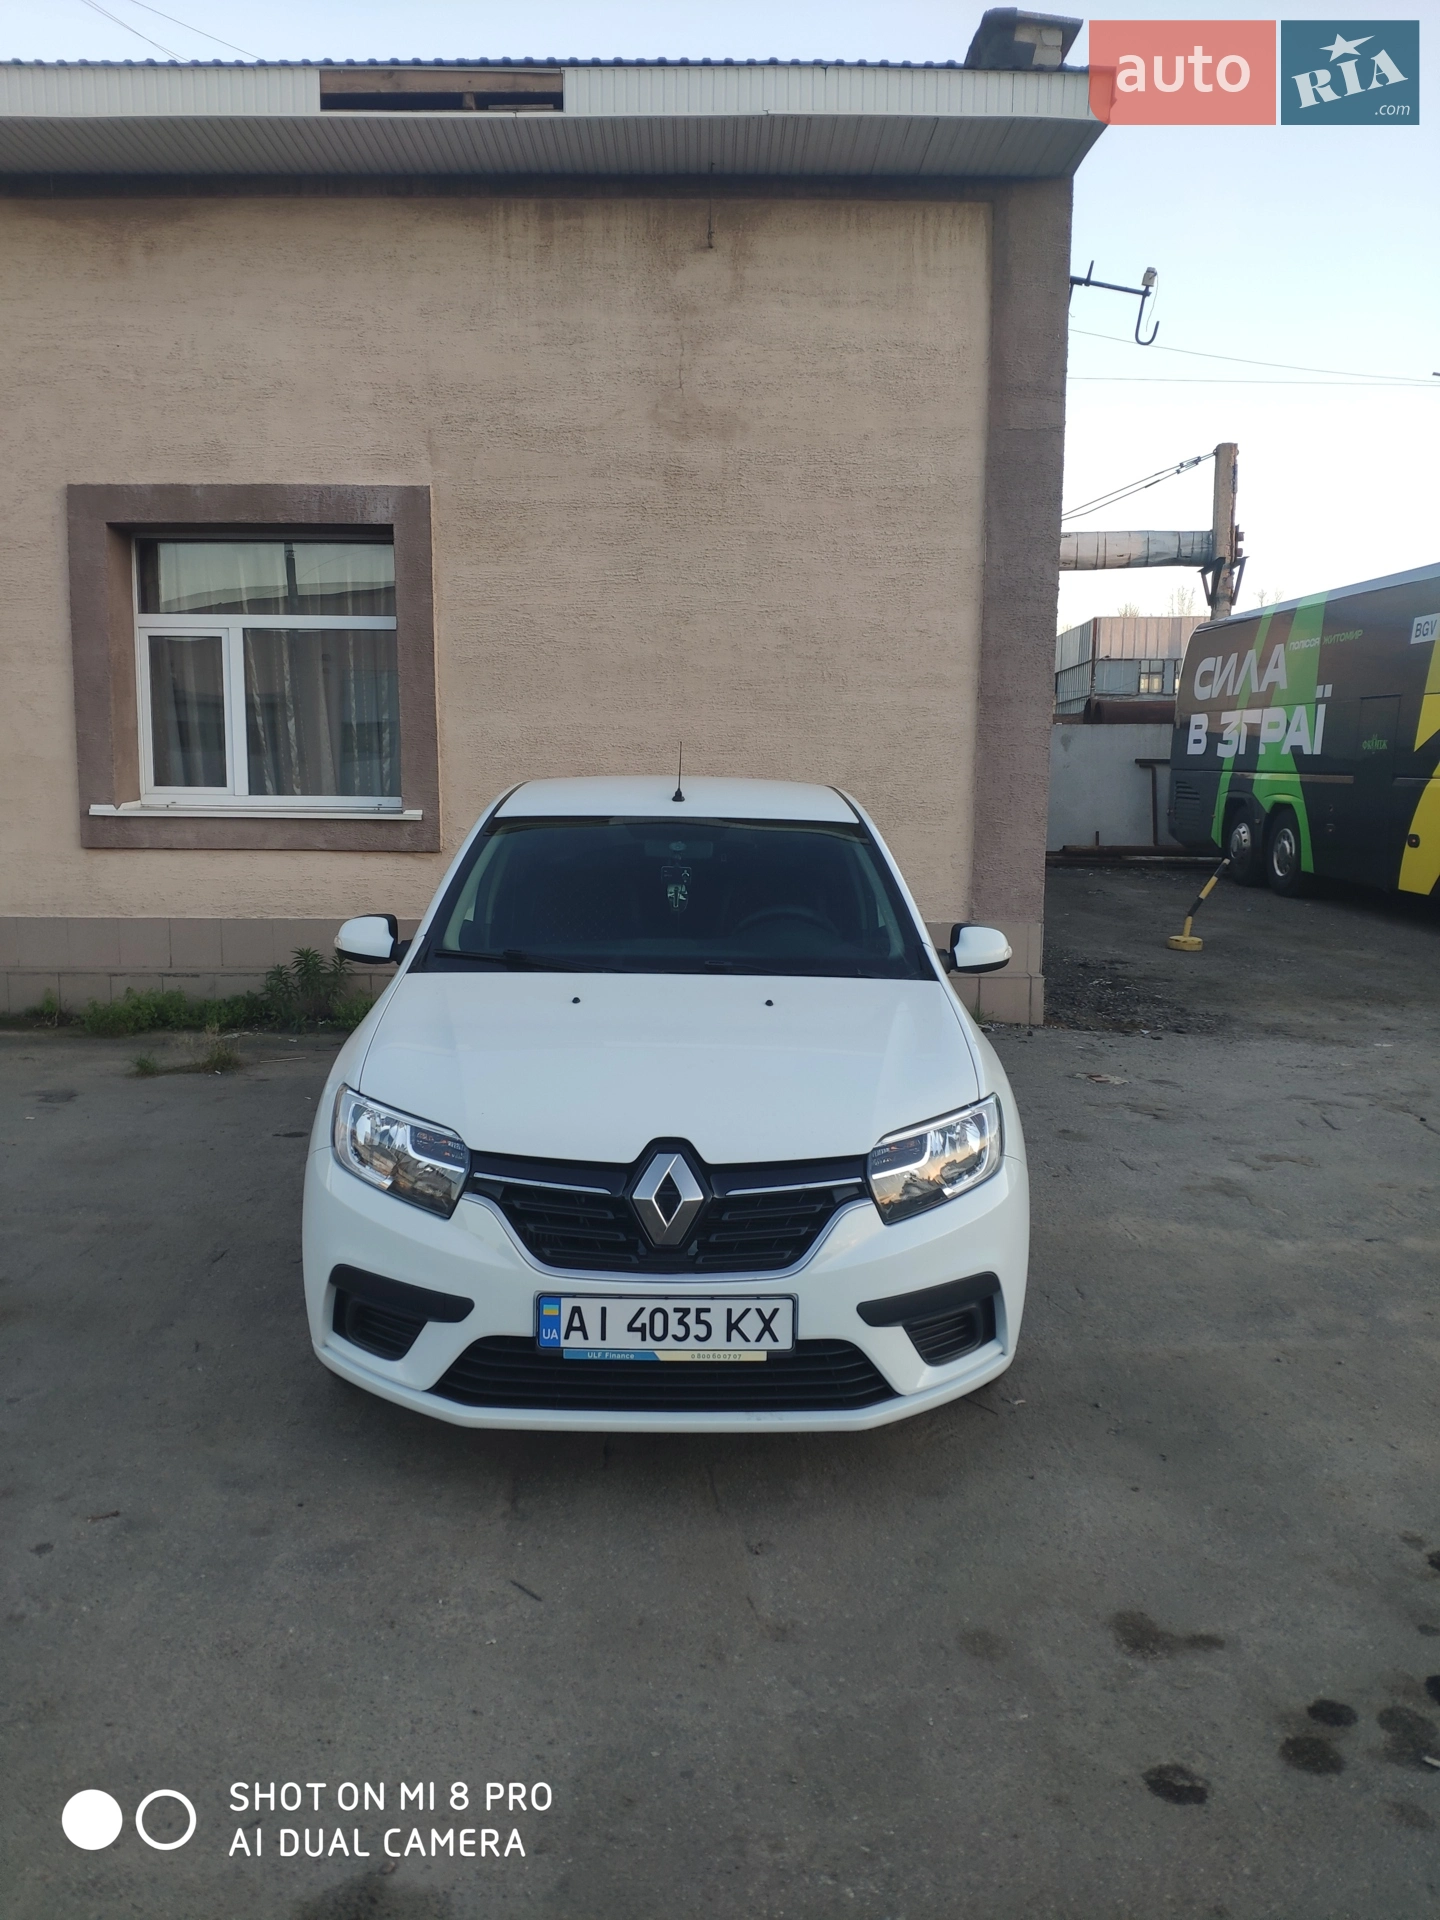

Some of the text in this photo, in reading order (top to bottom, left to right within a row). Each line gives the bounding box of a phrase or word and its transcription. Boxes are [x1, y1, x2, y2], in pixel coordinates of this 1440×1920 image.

[1414, 619, 1438, 639] BGV
[1193, 643, 1288, 701] СИЛА
[1186, 684, 1333, 758] В ЗГРАЇ
[542, 1328, 559, 1340] UA
[563, 1305, 780, 1343] AI 4035 KX
[587, 1351, 635, 1360] ULF Finance
